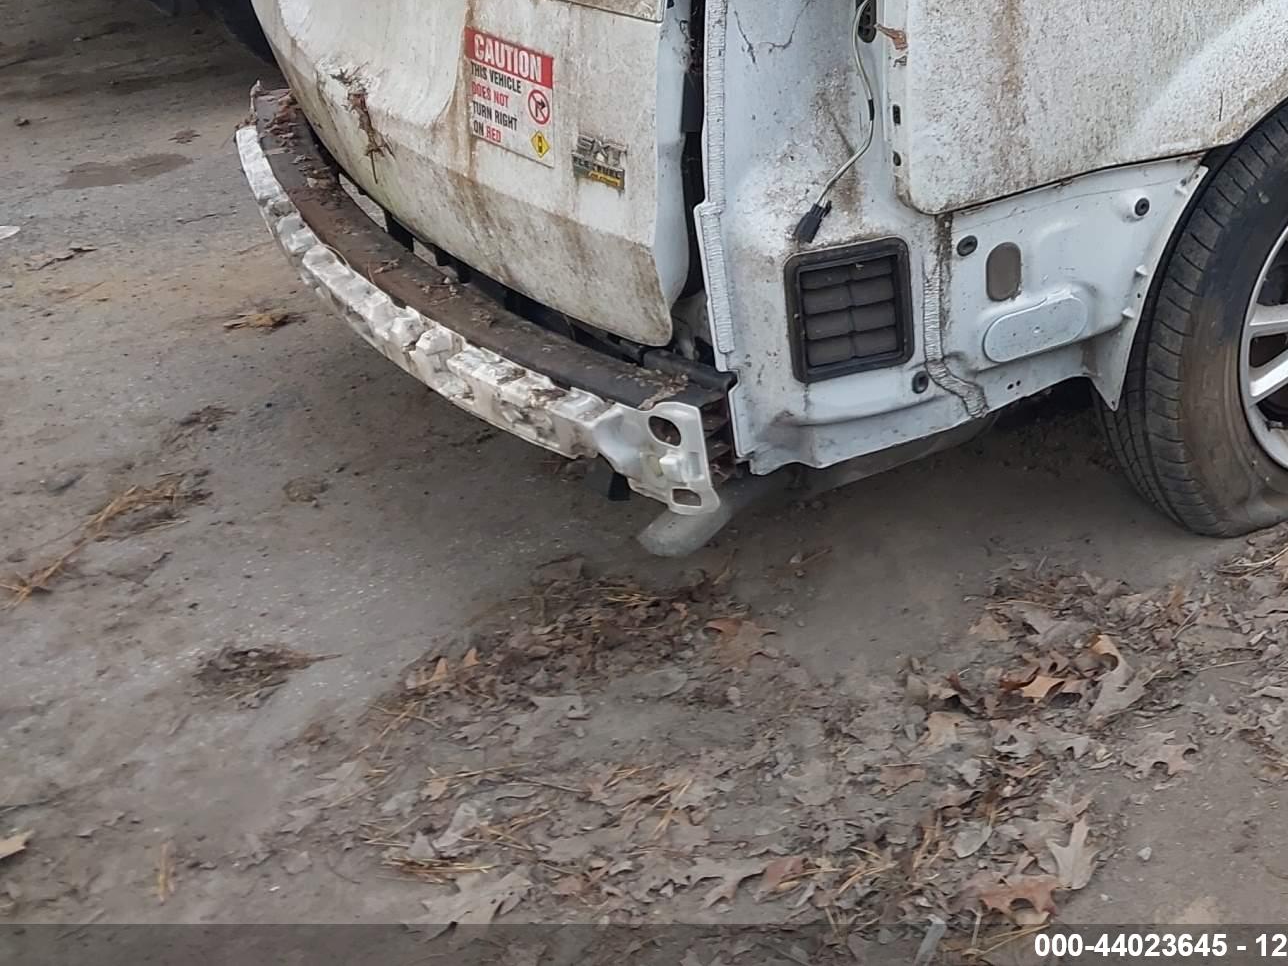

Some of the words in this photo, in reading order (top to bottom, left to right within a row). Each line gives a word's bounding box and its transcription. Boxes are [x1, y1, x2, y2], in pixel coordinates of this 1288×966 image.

[474, 35, 542, 82] CAUTION
[471, 61, 487, 80] THIS
[489, 69, 521, 94] VEHICLE
[471, 81, 491, 101] DOES
[494, 92, 509, 108] NOT
[472, 100, 492, 120] TURN
[494, 110, 517, 131] RIGHT
[473, 120, 484, 136] ON
[486, 126, 501, 143] RED
[576, 134, 627, 166] SXT
